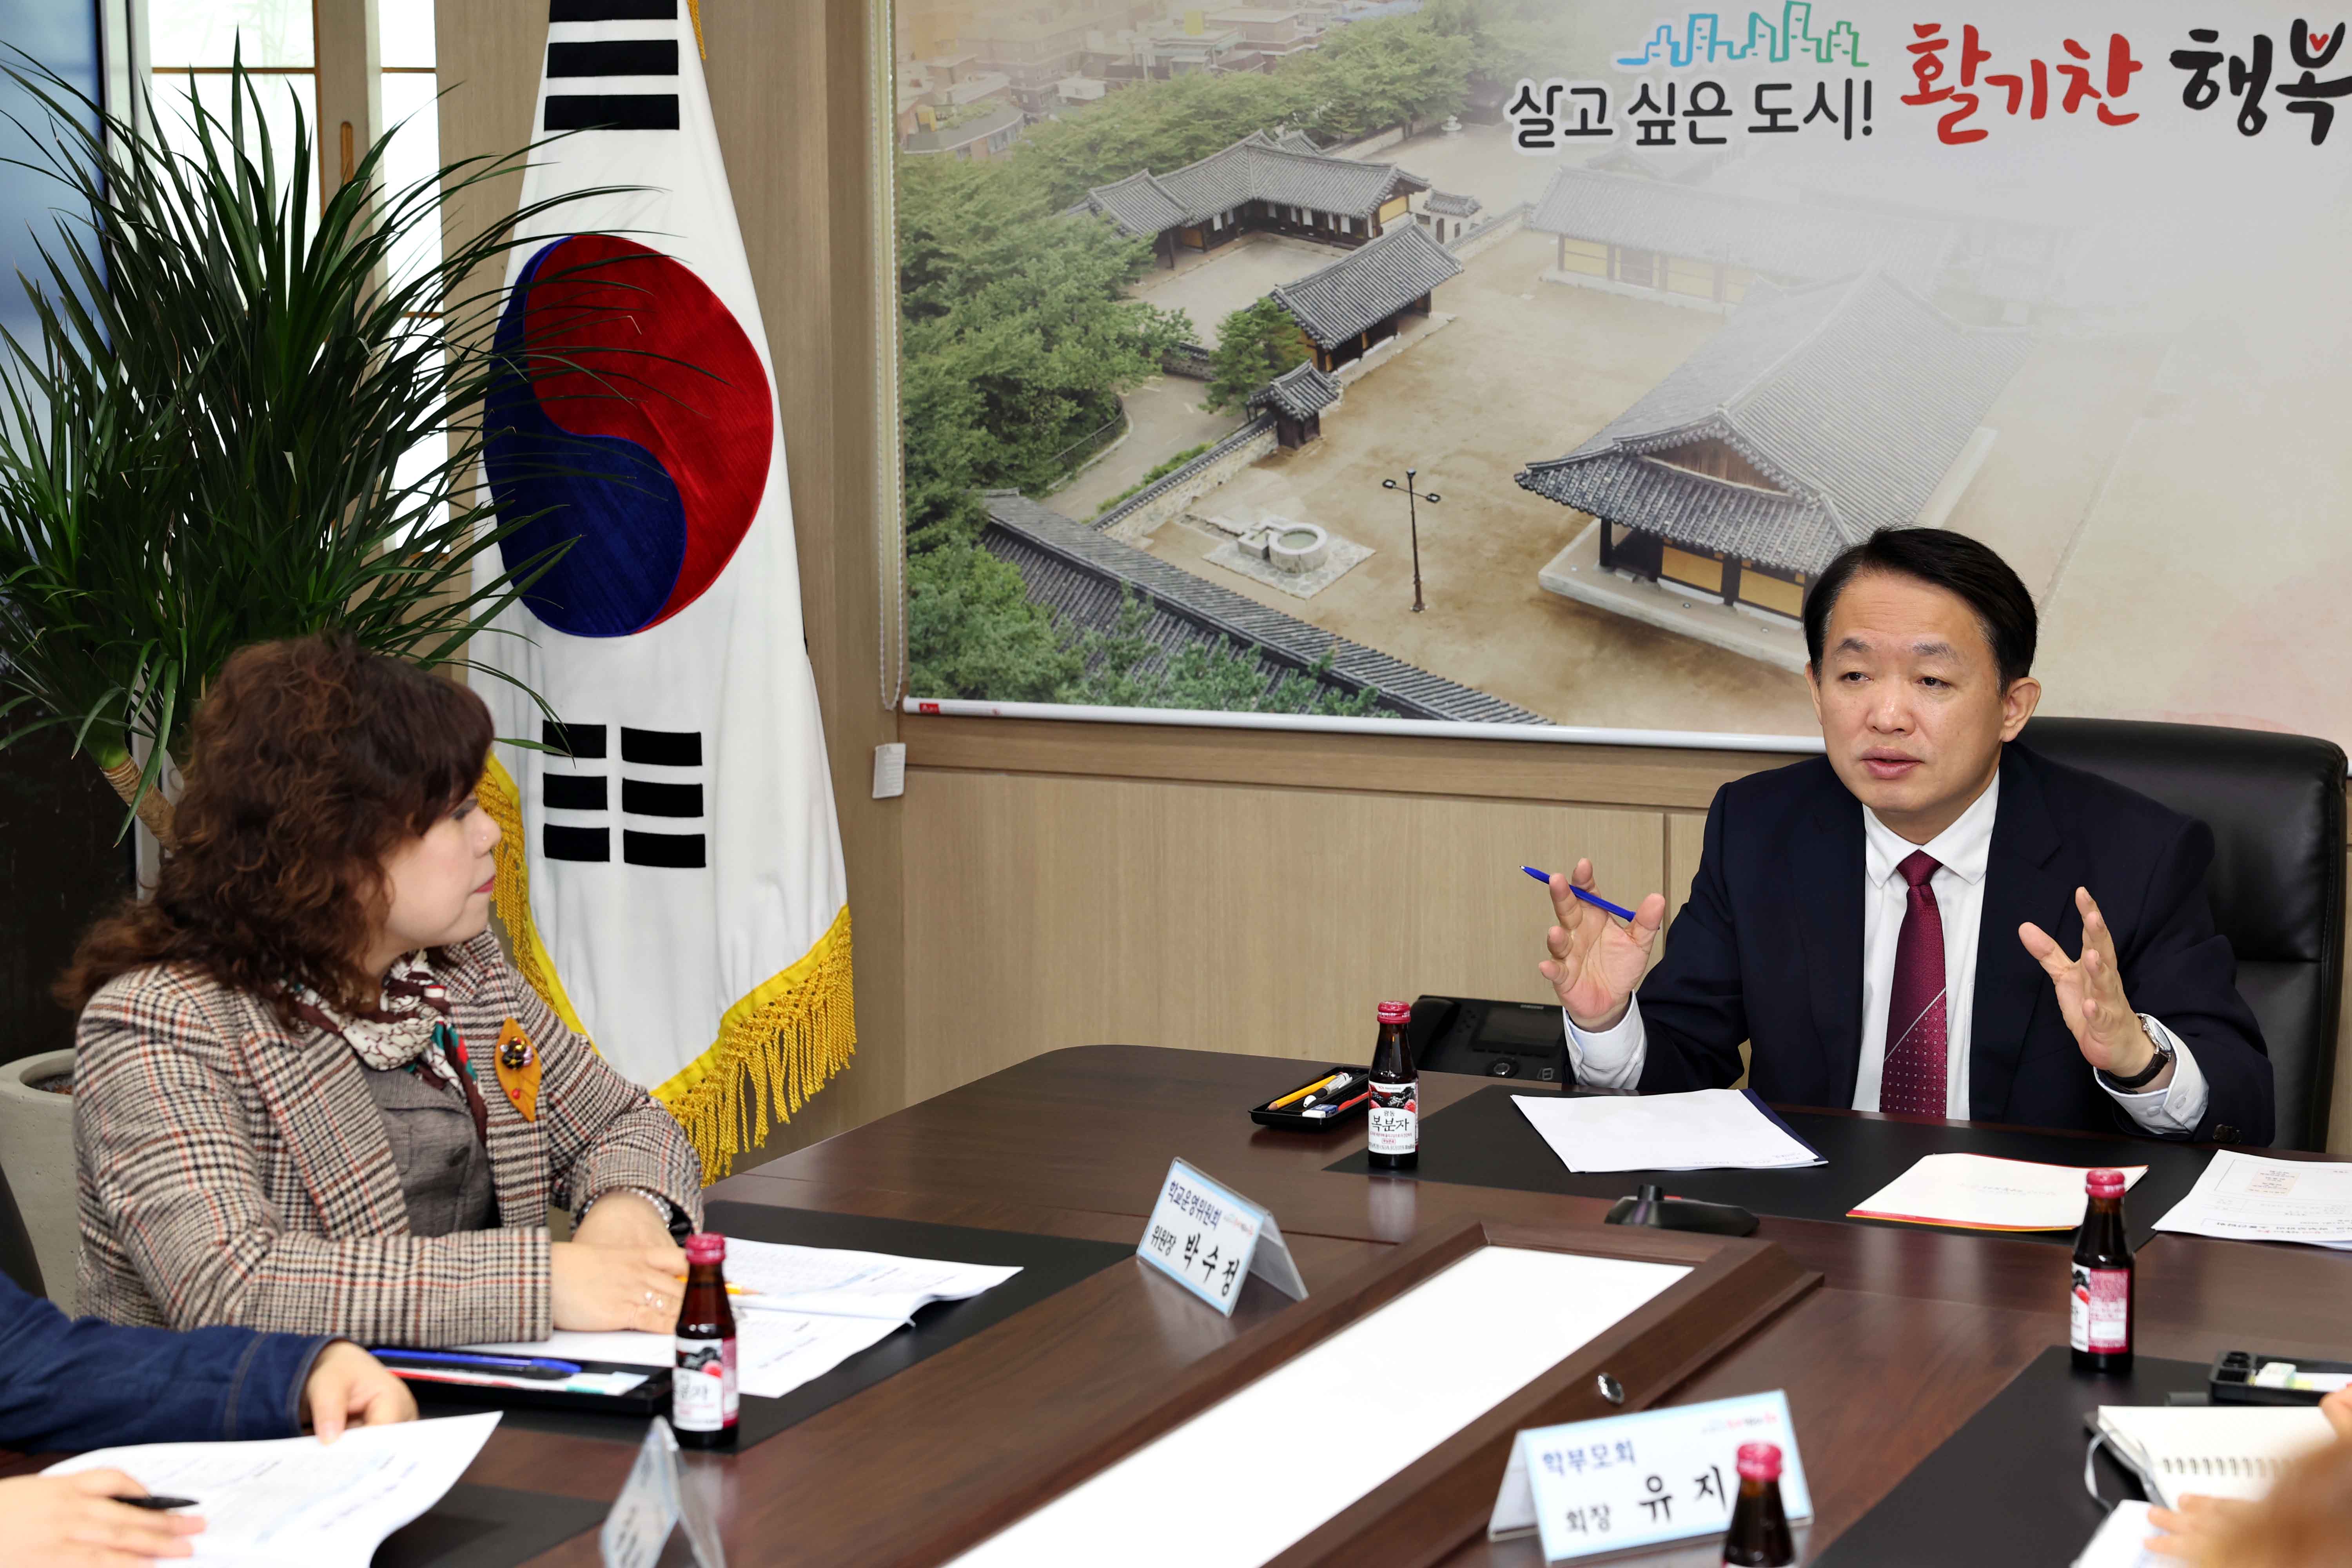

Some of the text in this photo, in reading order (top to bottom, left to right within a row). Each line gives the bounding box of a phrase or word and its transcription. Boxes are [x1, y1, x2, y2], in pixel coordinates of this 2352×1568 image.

[1509, 18, 2352, 148] 살고 싶은 도시! 활기찬 행복
[1372, 1115, 1409, 1132] 복분자
[1169, 1181, 1222, 1230] 학교운영위원회
[1151, 1225, 1177, 1256] 위원장
[1542, 1439, 1636, 1476] 학부모회
[1565, 1504, 1611, 1534] 회장
